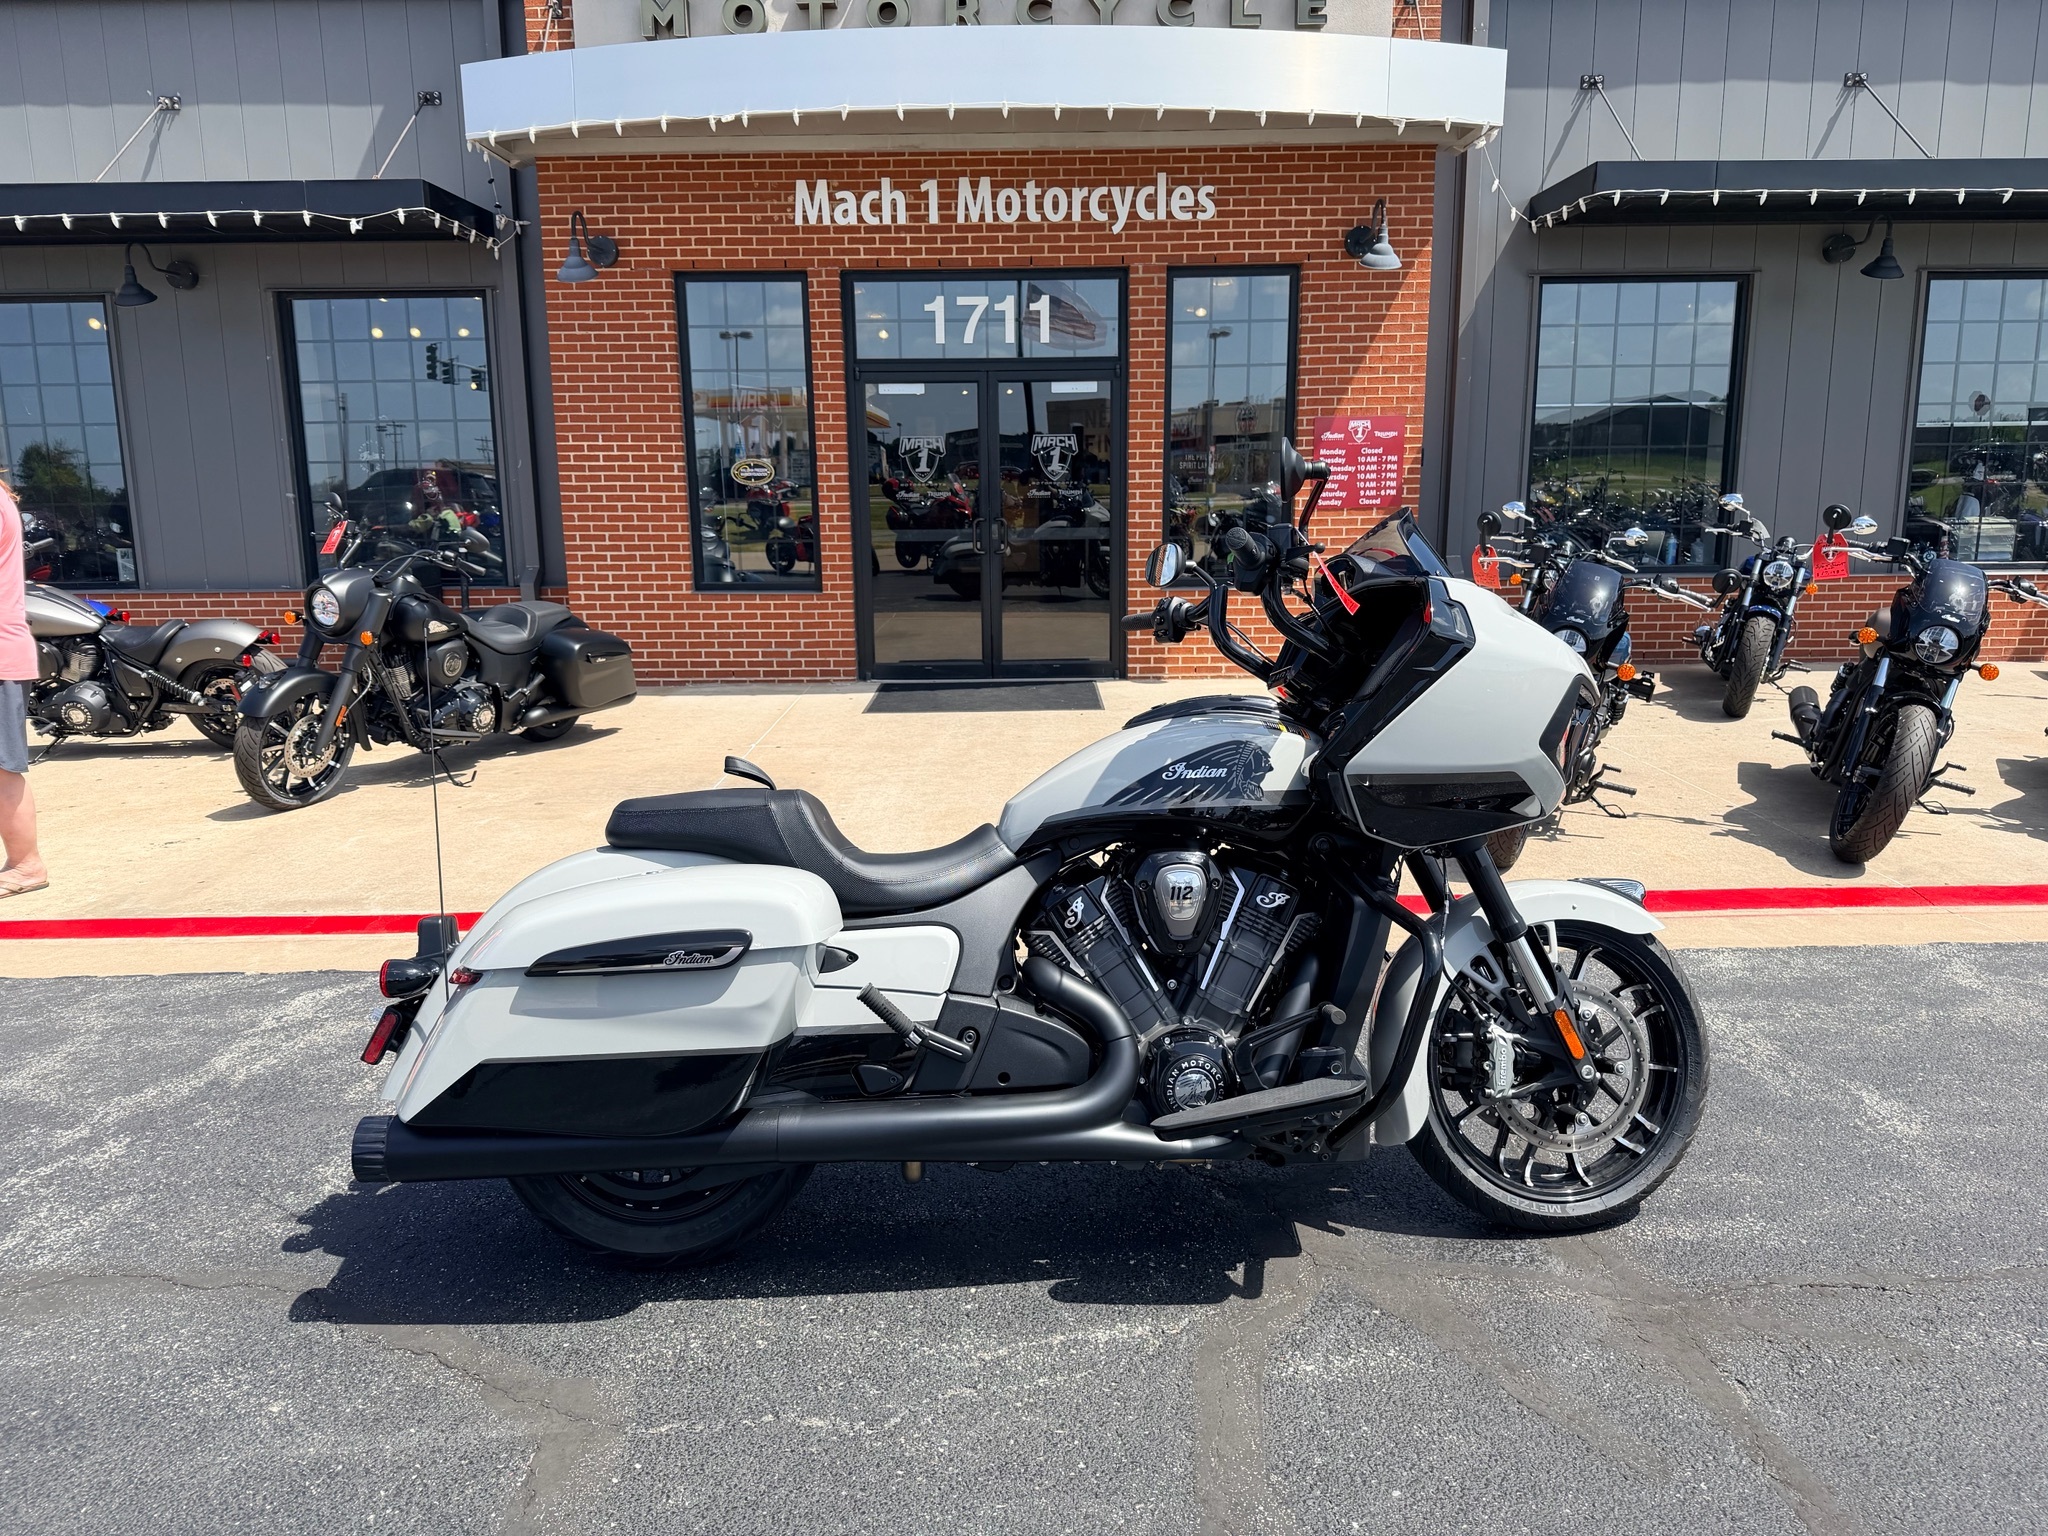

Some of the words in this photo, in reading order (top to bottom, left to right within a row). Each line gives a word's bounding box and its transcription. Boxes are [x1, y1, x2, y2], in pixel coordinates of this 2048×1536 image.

[794, 177, 907, 226] Mach
[919, 178, 939, 225] 1
[956, 172, 1216, 235] Motorcycles
[923, 294, 1051, 345] 1711
[1374, 430, 1398, 438] TRIUMPH
[901, 438, 945, 453] MACH
[1033, 436, 1077, 452] MACH
[1320, 448, 1346, 456] Monday
[915, 448, 931, 472] 1
[1047, 447, 1062, 471] 1
[1329, 473, 1349, 481] rsday
[1331, 465, 1356, 473] dnesday
[1325, 482, 1339, 490] iday
[1317, 499, 1342, 507] Sunday
[1162, 762, 1228, 781] Indian
[1170, 886, 1194, 900] 112
[664, 950, 713, 966] Indian
[1498, 1047, 1507, 1087] brembo
[1166, 1068, 1180, 1109] INDIAN
